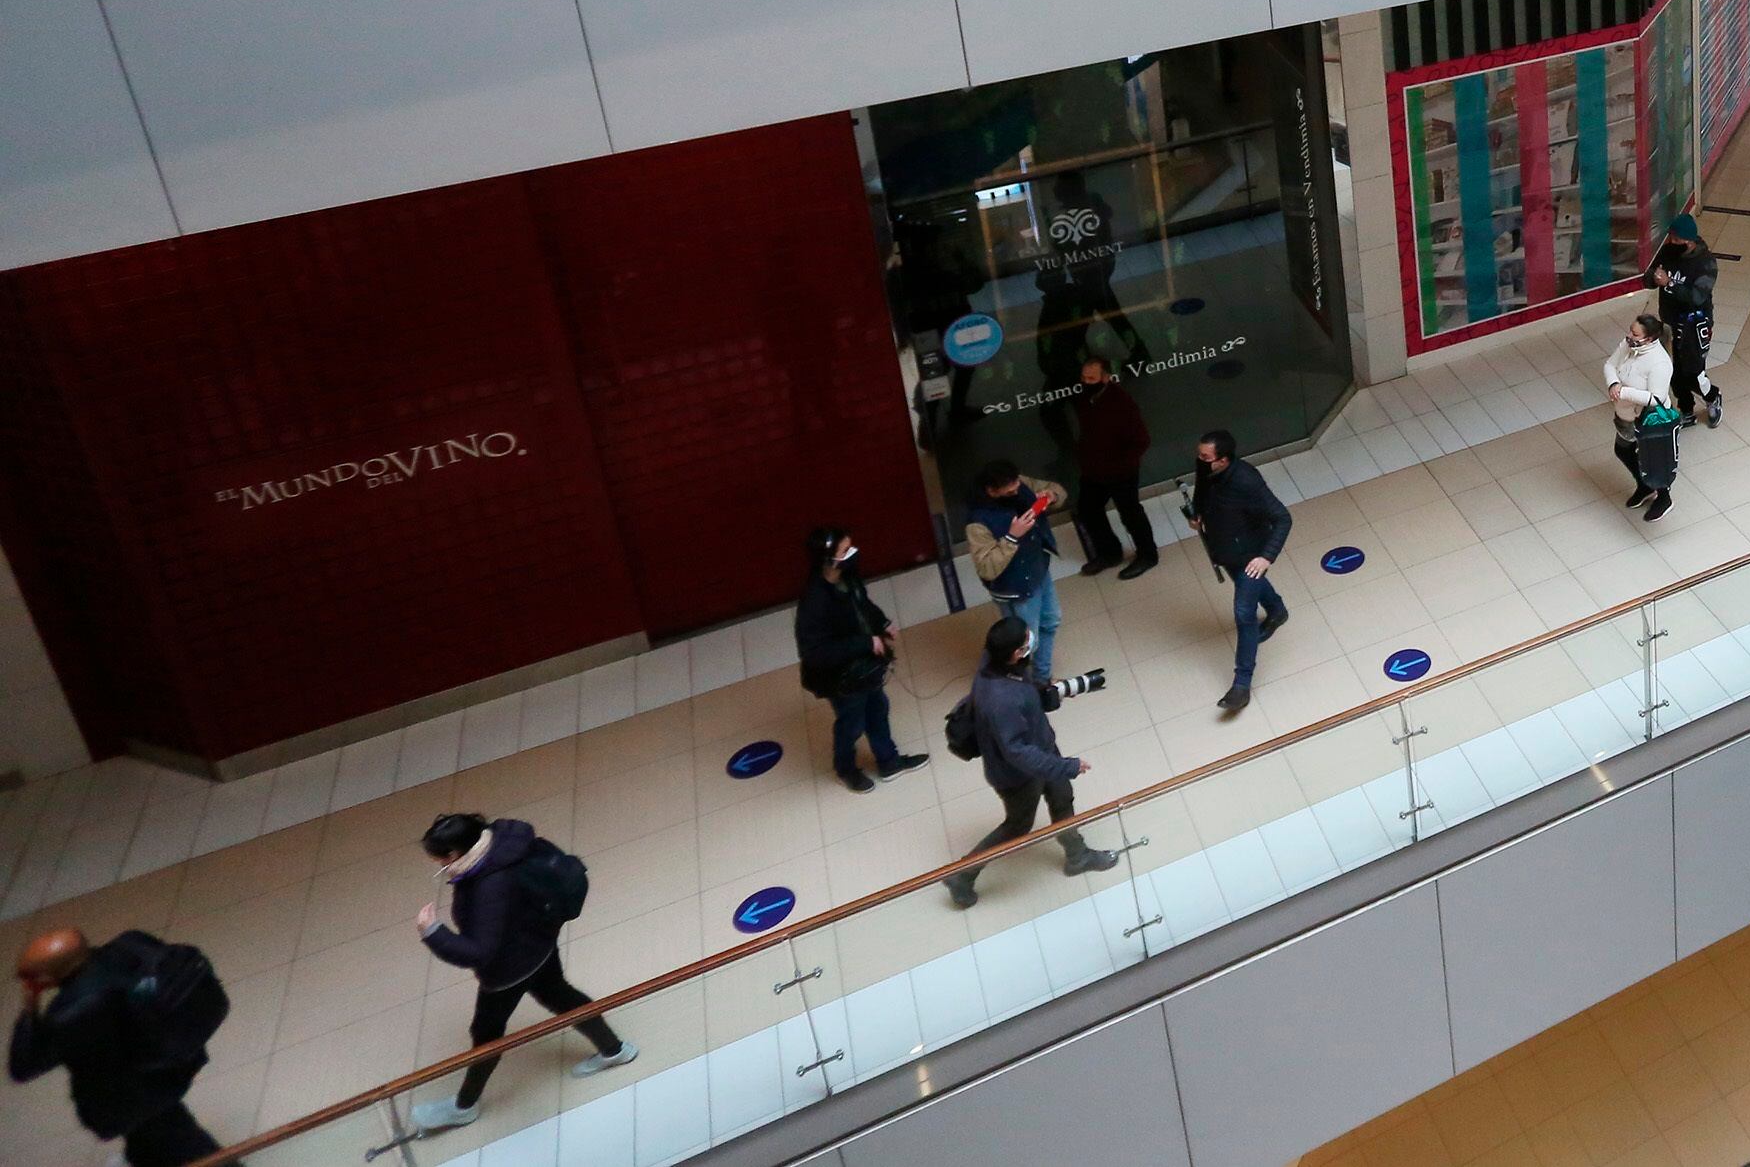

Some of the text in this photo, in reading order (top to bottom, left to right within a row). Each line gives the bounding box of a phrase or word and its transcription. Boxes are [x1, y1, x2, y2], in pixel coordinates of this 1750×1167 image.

[1299, 113, 1322, 286] Estamos en Vendimia
[1034, 241, 1124, 271] VIU MANENT
[1016, 382, 1083, 411] Estamo
[1127, 345, 1217, 379] Vendimia
[214, 488, 239, 503] EL
[241, 457, 389, 511] MUNDO
[367, 471, 404, 490] DEL
